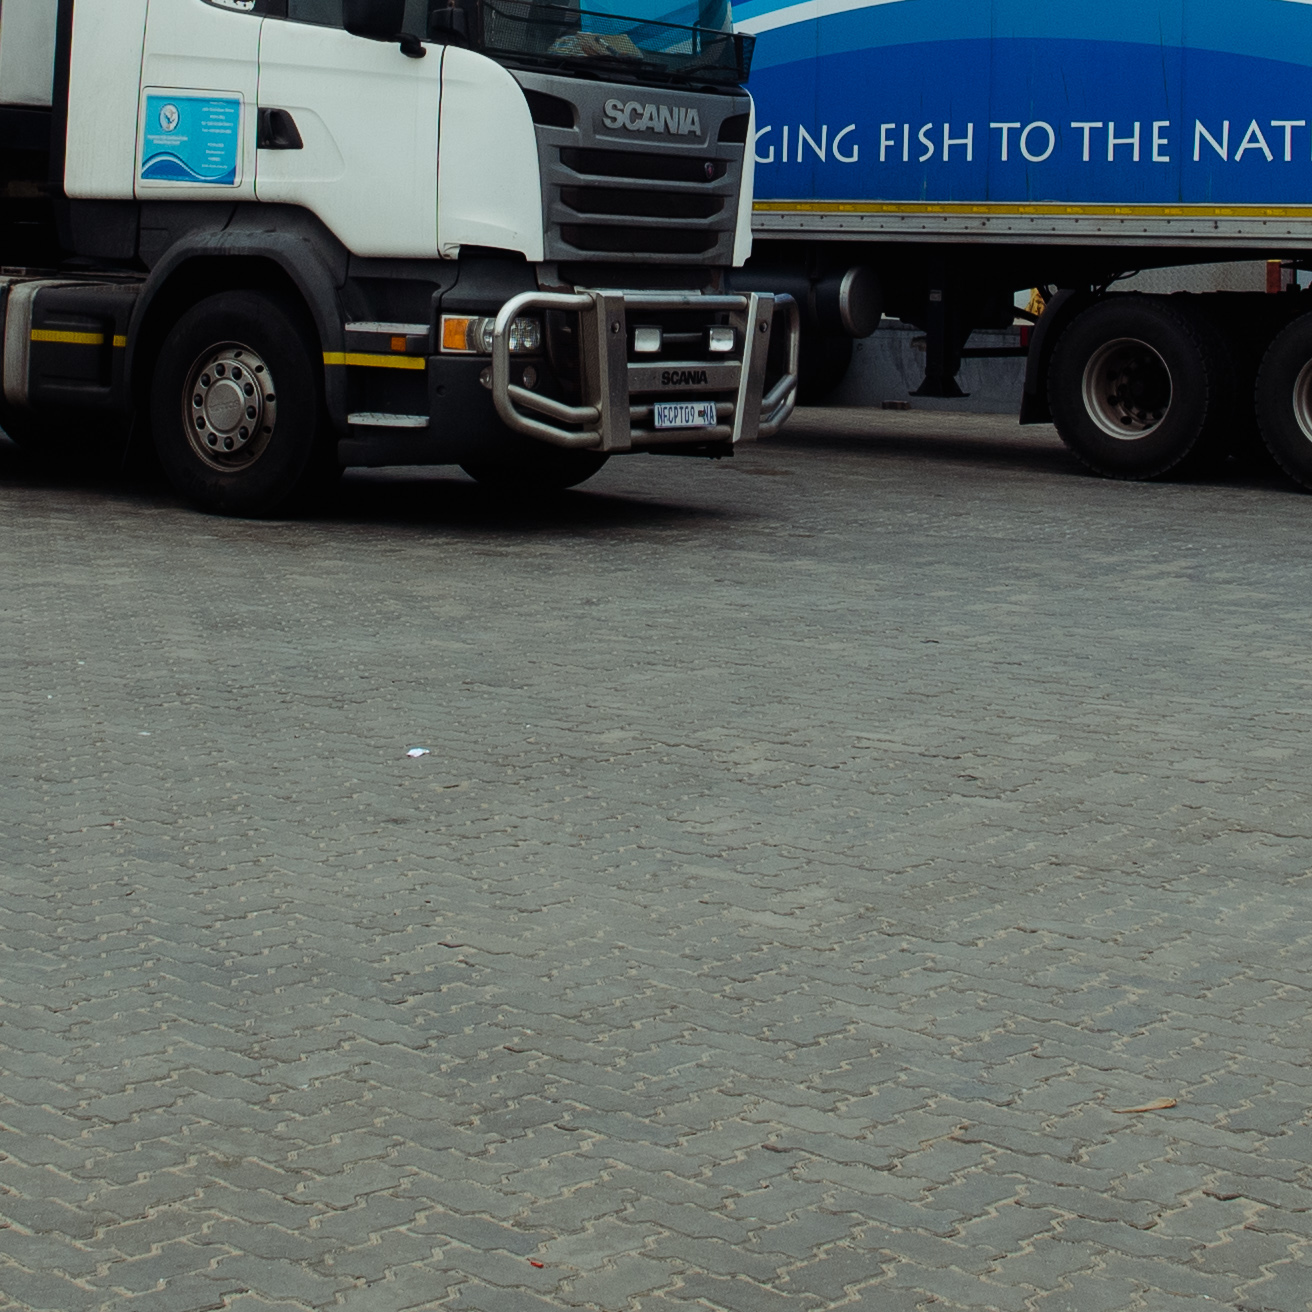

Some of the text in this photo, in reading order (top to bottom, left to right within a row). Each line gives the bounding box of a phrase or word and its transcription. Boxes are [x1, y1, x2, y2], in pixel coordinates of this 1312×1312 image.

[601, 98, 702, 136] SCANIA
[754, 123, 859, 163] GING
[879, 122, 974, 163] FISH
[989, 121, 1056, 163] TO
[1070, 120, 1171, 163] THE
[661, 370, 708, 385] SCANIA
